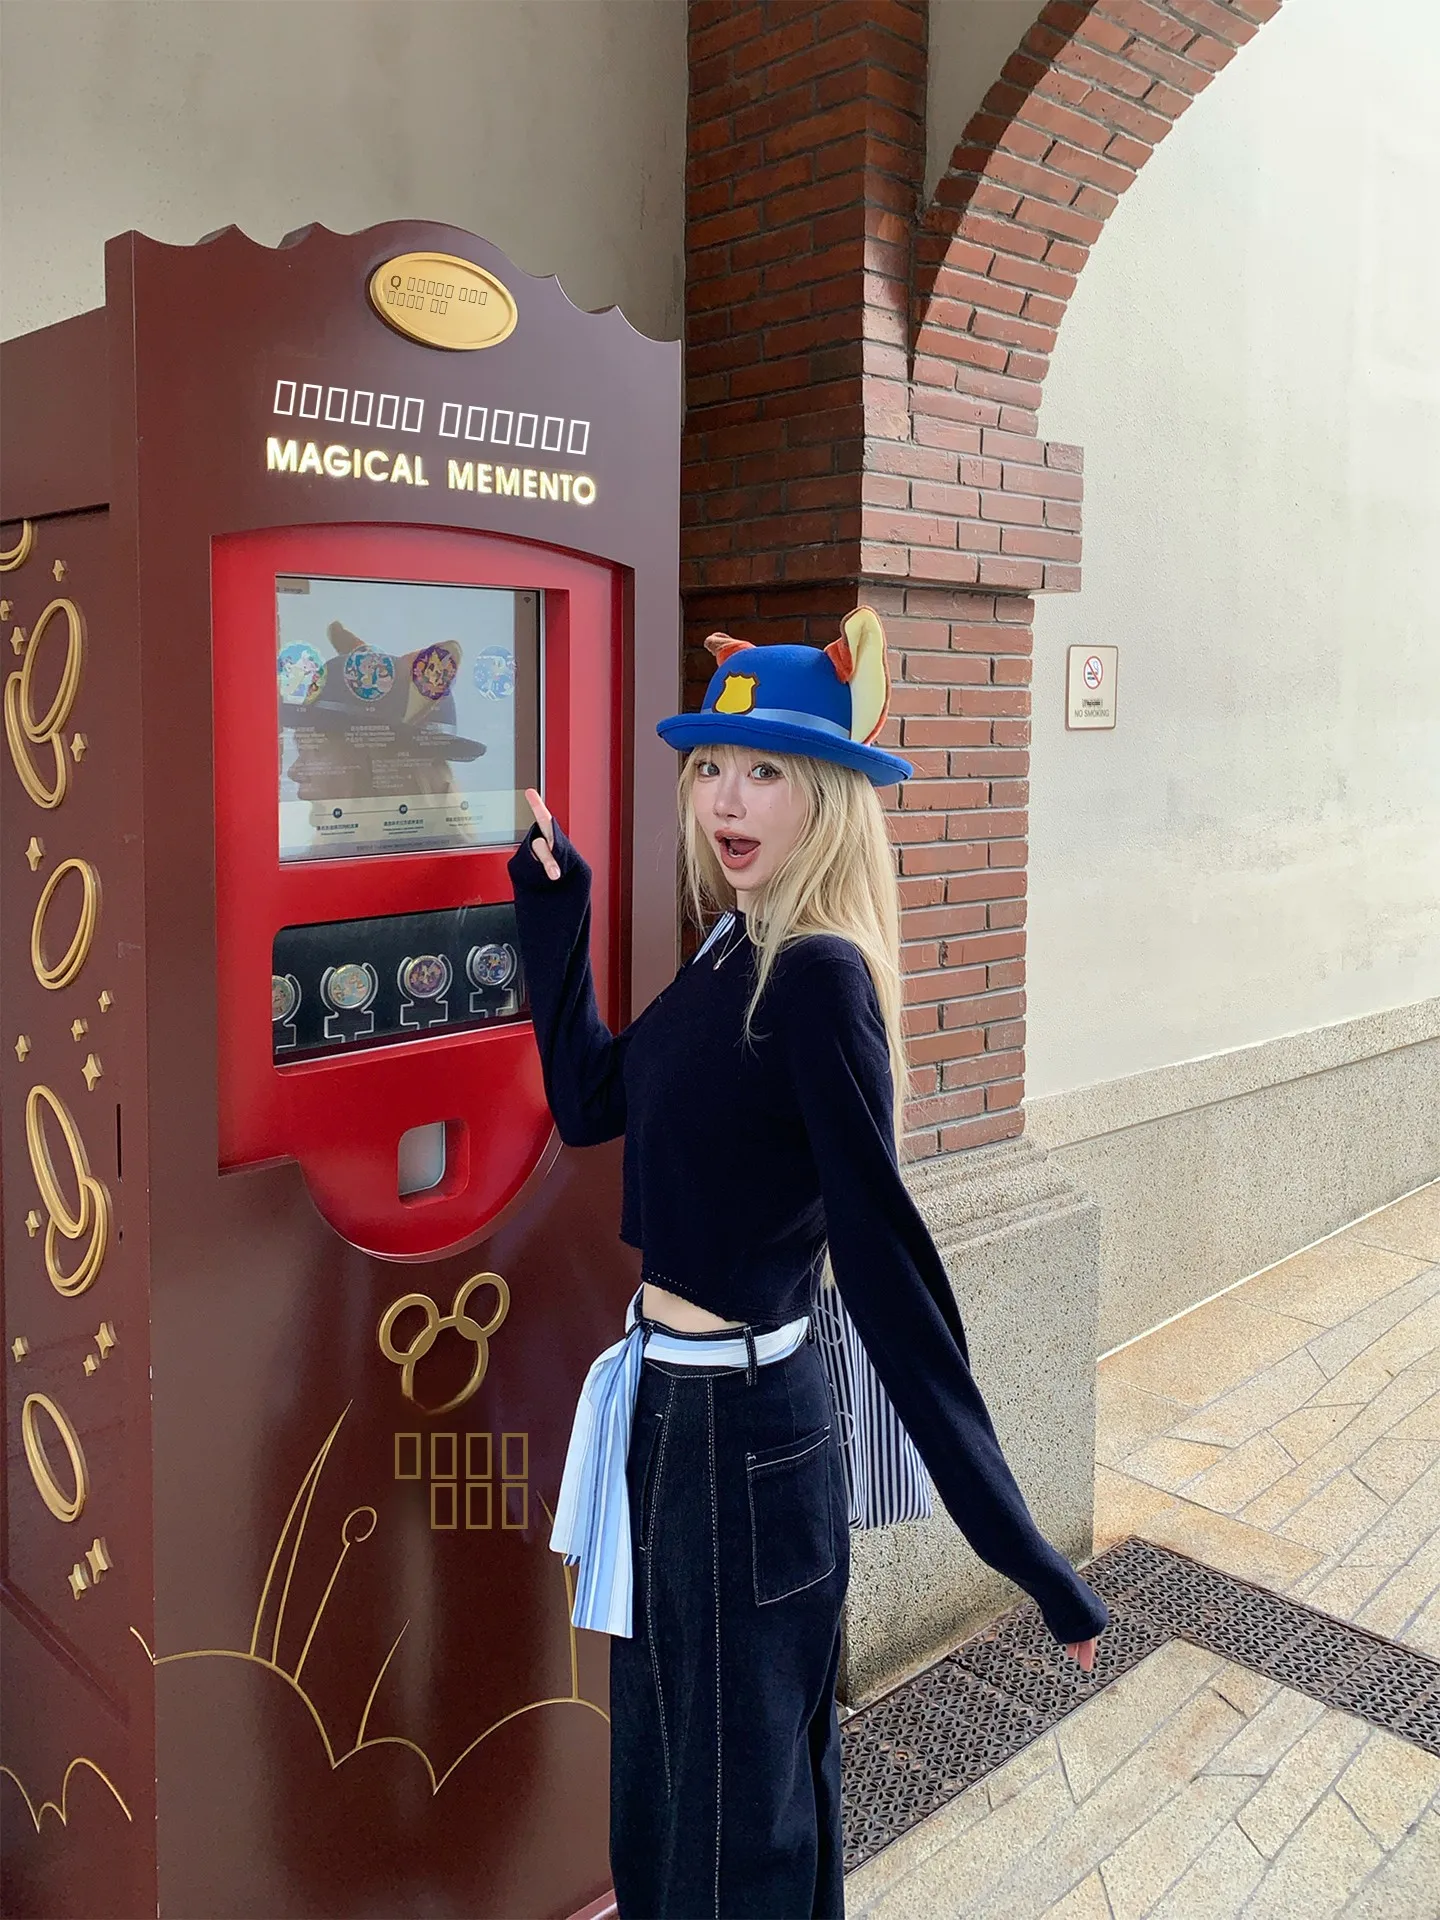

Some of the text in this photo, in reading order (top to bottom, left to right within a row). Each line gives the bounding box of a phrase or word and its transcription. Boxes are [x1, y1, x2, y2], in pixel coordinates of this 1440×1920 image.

[266, 435, 597, 506] MAGICAL MEMENTO
[1074, 709, 1110, 718] NO SMOKING
